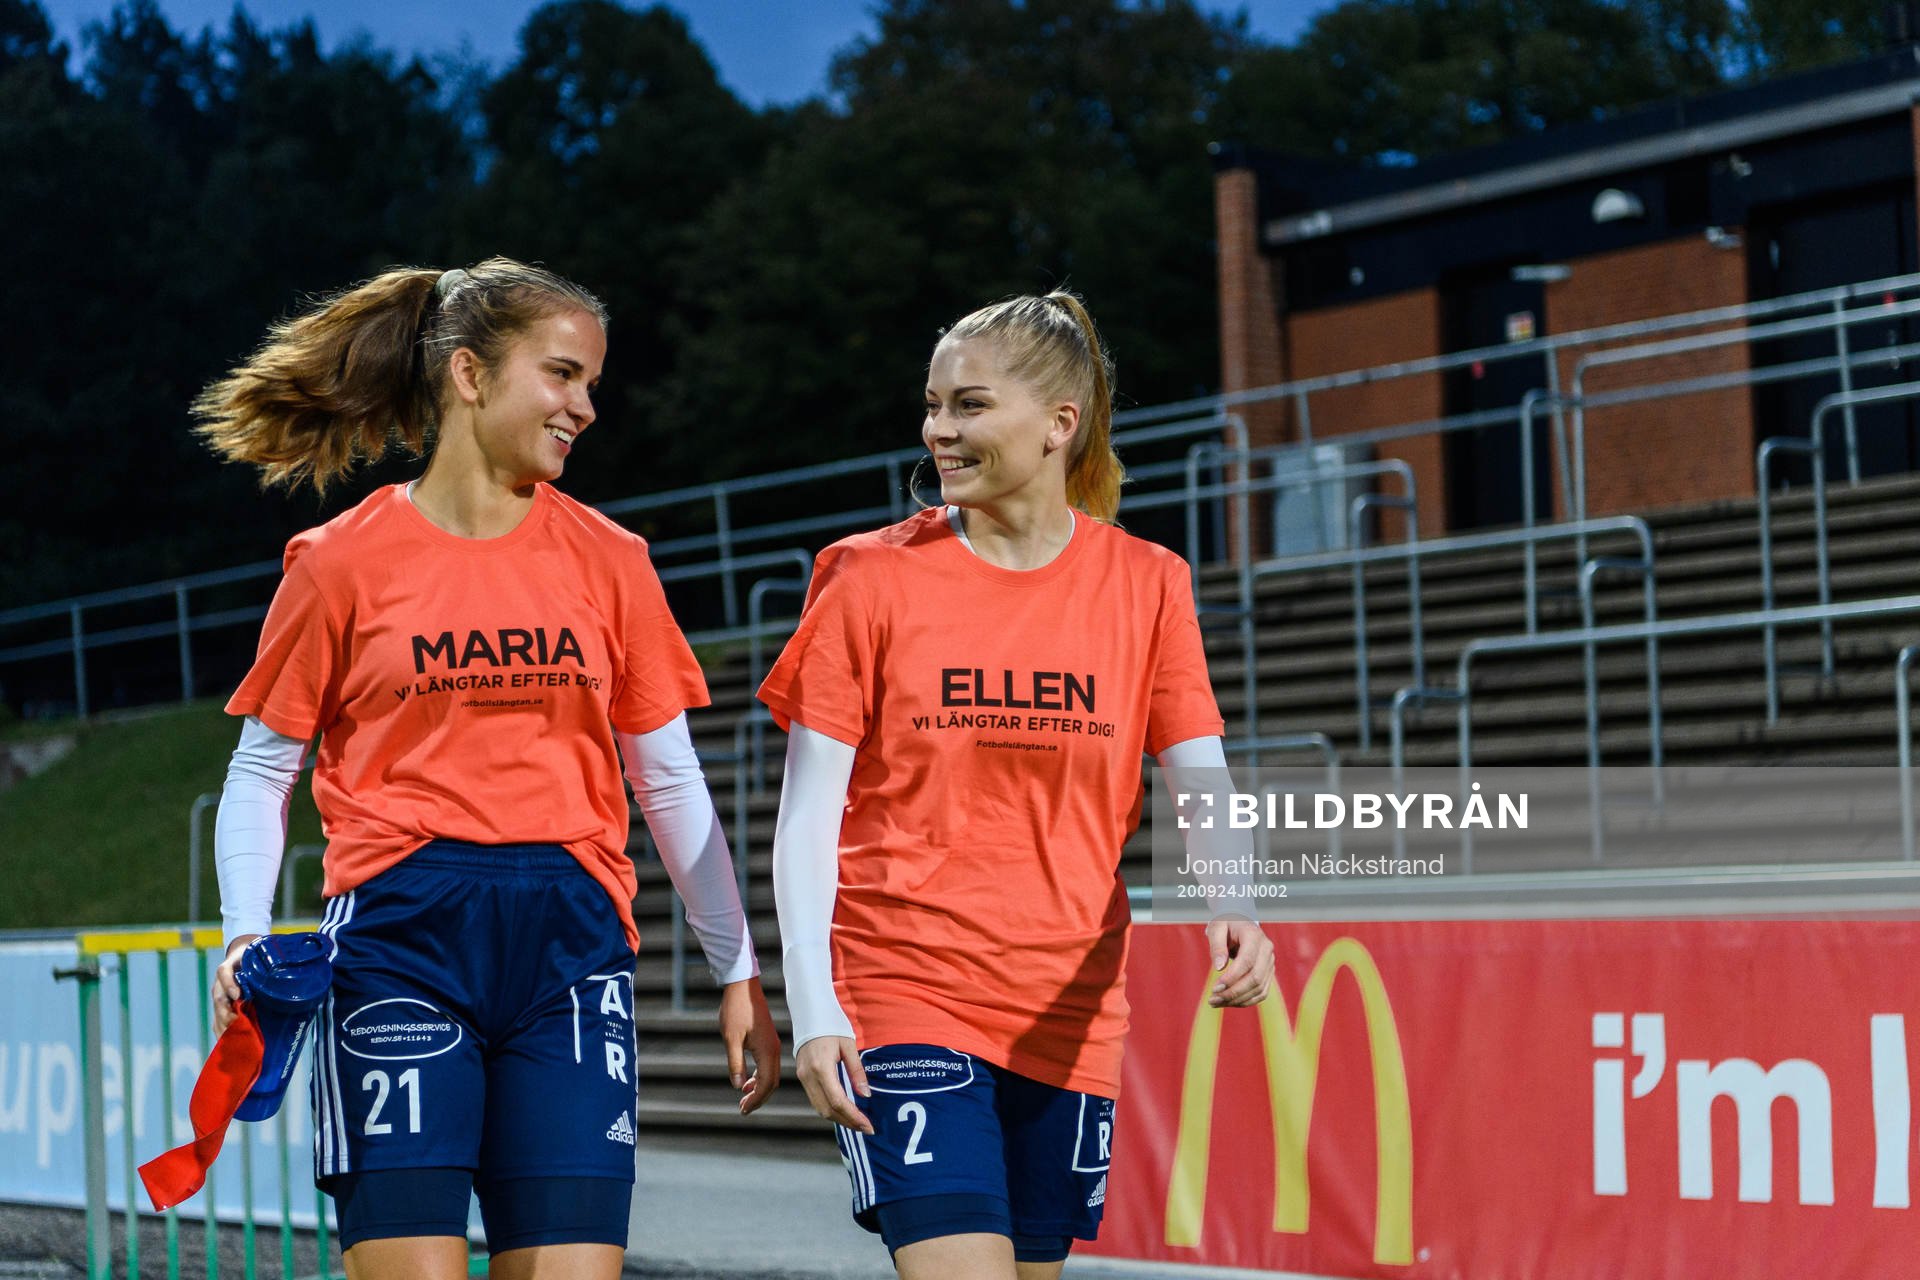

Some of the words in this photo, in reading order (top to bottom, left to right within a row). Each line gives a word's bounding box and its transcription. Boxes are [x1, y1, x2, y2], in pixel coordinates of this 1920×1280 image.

[412, 628, 586, 674] MARIA
[415, 675, 504, 696] LÄNGTAR
[511, 673, 570, 688] EFTER
[942, 668, 1095, 713] ELLEN
[912, 716, 929, 730] VI
[937, 711, 1021, 730] LÄNGTAR
[1028, 717, 1083, 734] EFTER
[1088, 722, 1115, 738] DIG!
[600, 979, 628, 1020] A
[351, 1023, 451, 1037] REDOVISNINGSSERVICE
[605, 1041, 628, 1084] R
[865, 1059, 963, 1072] REDOVISNINGSSERVICE
[362, 1068, 421, 1136] 21
[1592, 1012, 1835, 1207] i'm
[897, 1101, 934, 1165] 2
[1098, 1121, 1111, 1160] R
